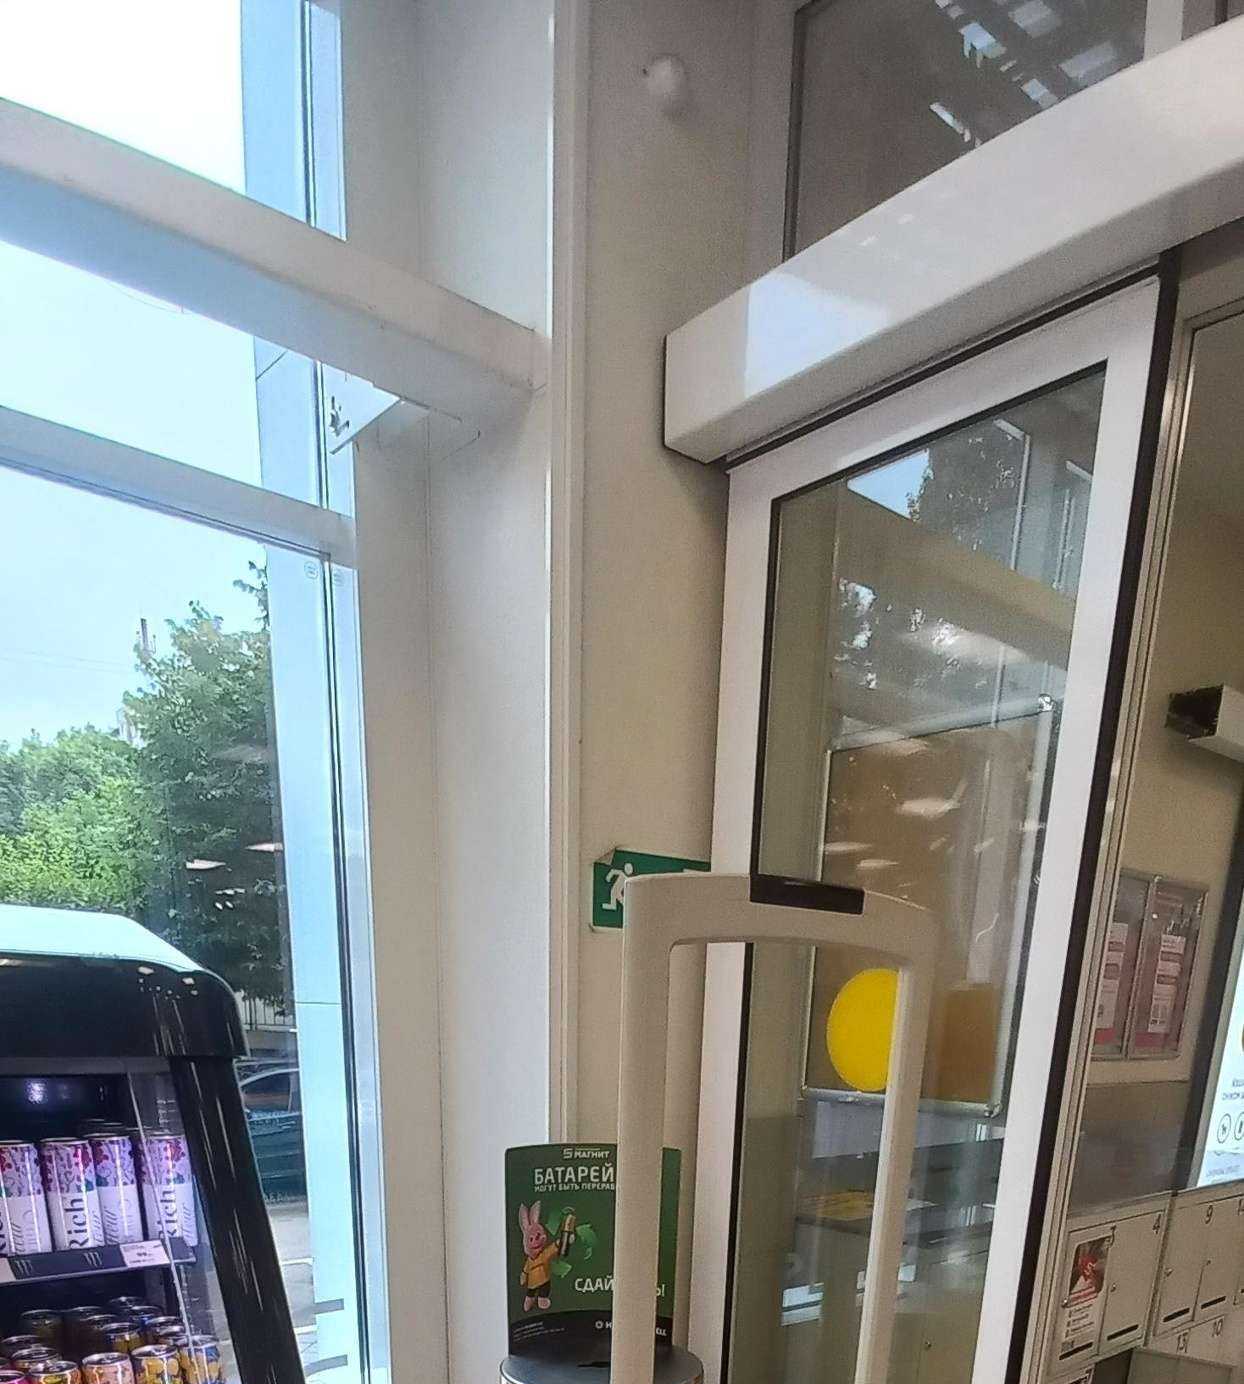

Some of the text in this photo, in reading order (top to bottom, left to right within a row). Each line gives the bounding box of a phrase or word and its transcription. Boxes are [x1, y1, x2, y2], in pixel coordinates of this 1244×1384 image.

[574, 1151, 610, 1159] МАГНИТ
[534, 1162, 615, 1185] БАТАРЕЙ
[581, 1182, 615, 1191] ПЕРЕРАБ
[574, 1274, 616, 1292] СДАЙ
